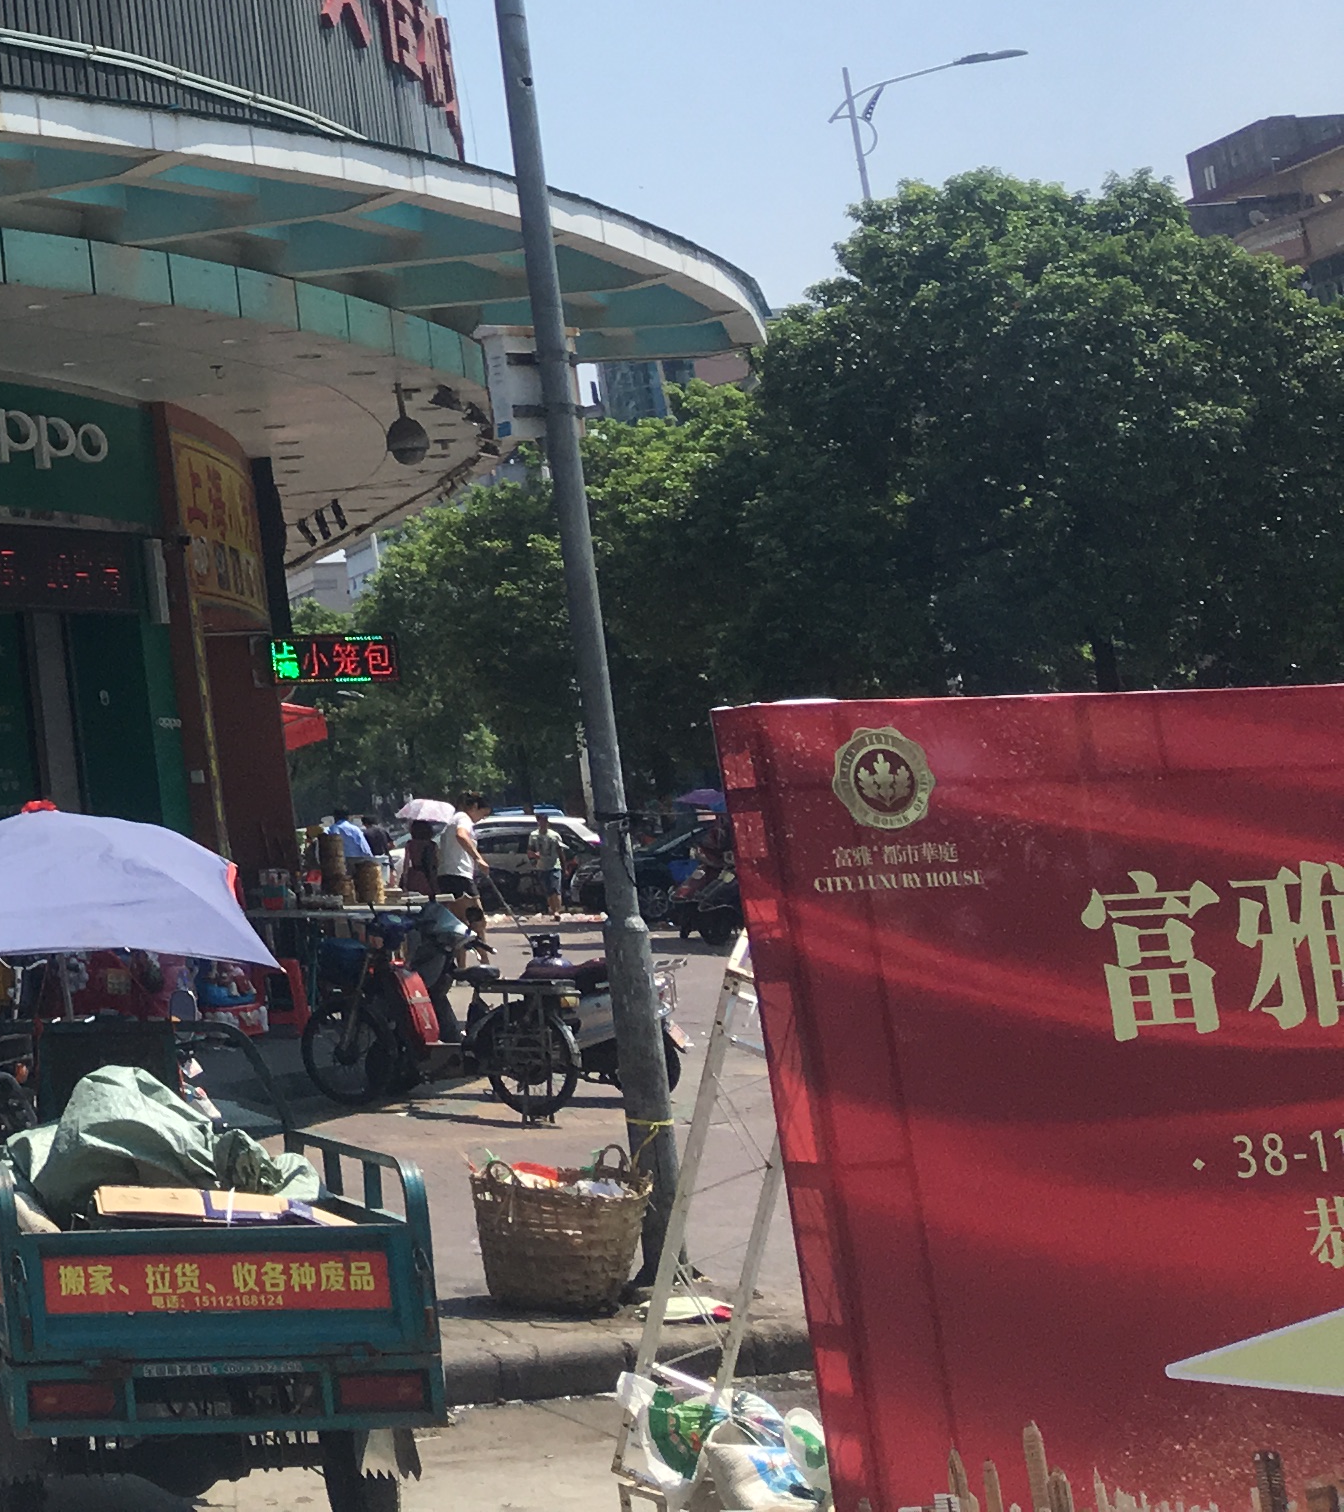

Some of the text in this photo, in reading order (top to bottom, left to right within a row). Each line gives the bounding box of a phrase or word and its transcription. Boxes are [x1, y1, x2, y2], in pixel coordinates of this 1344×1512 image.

[302, 642, 393, 677] 小笼包
[813, 869, 985, 893] CITY LUXURY HOUSE
[1080, 861, 1344, 1042] 富雅
